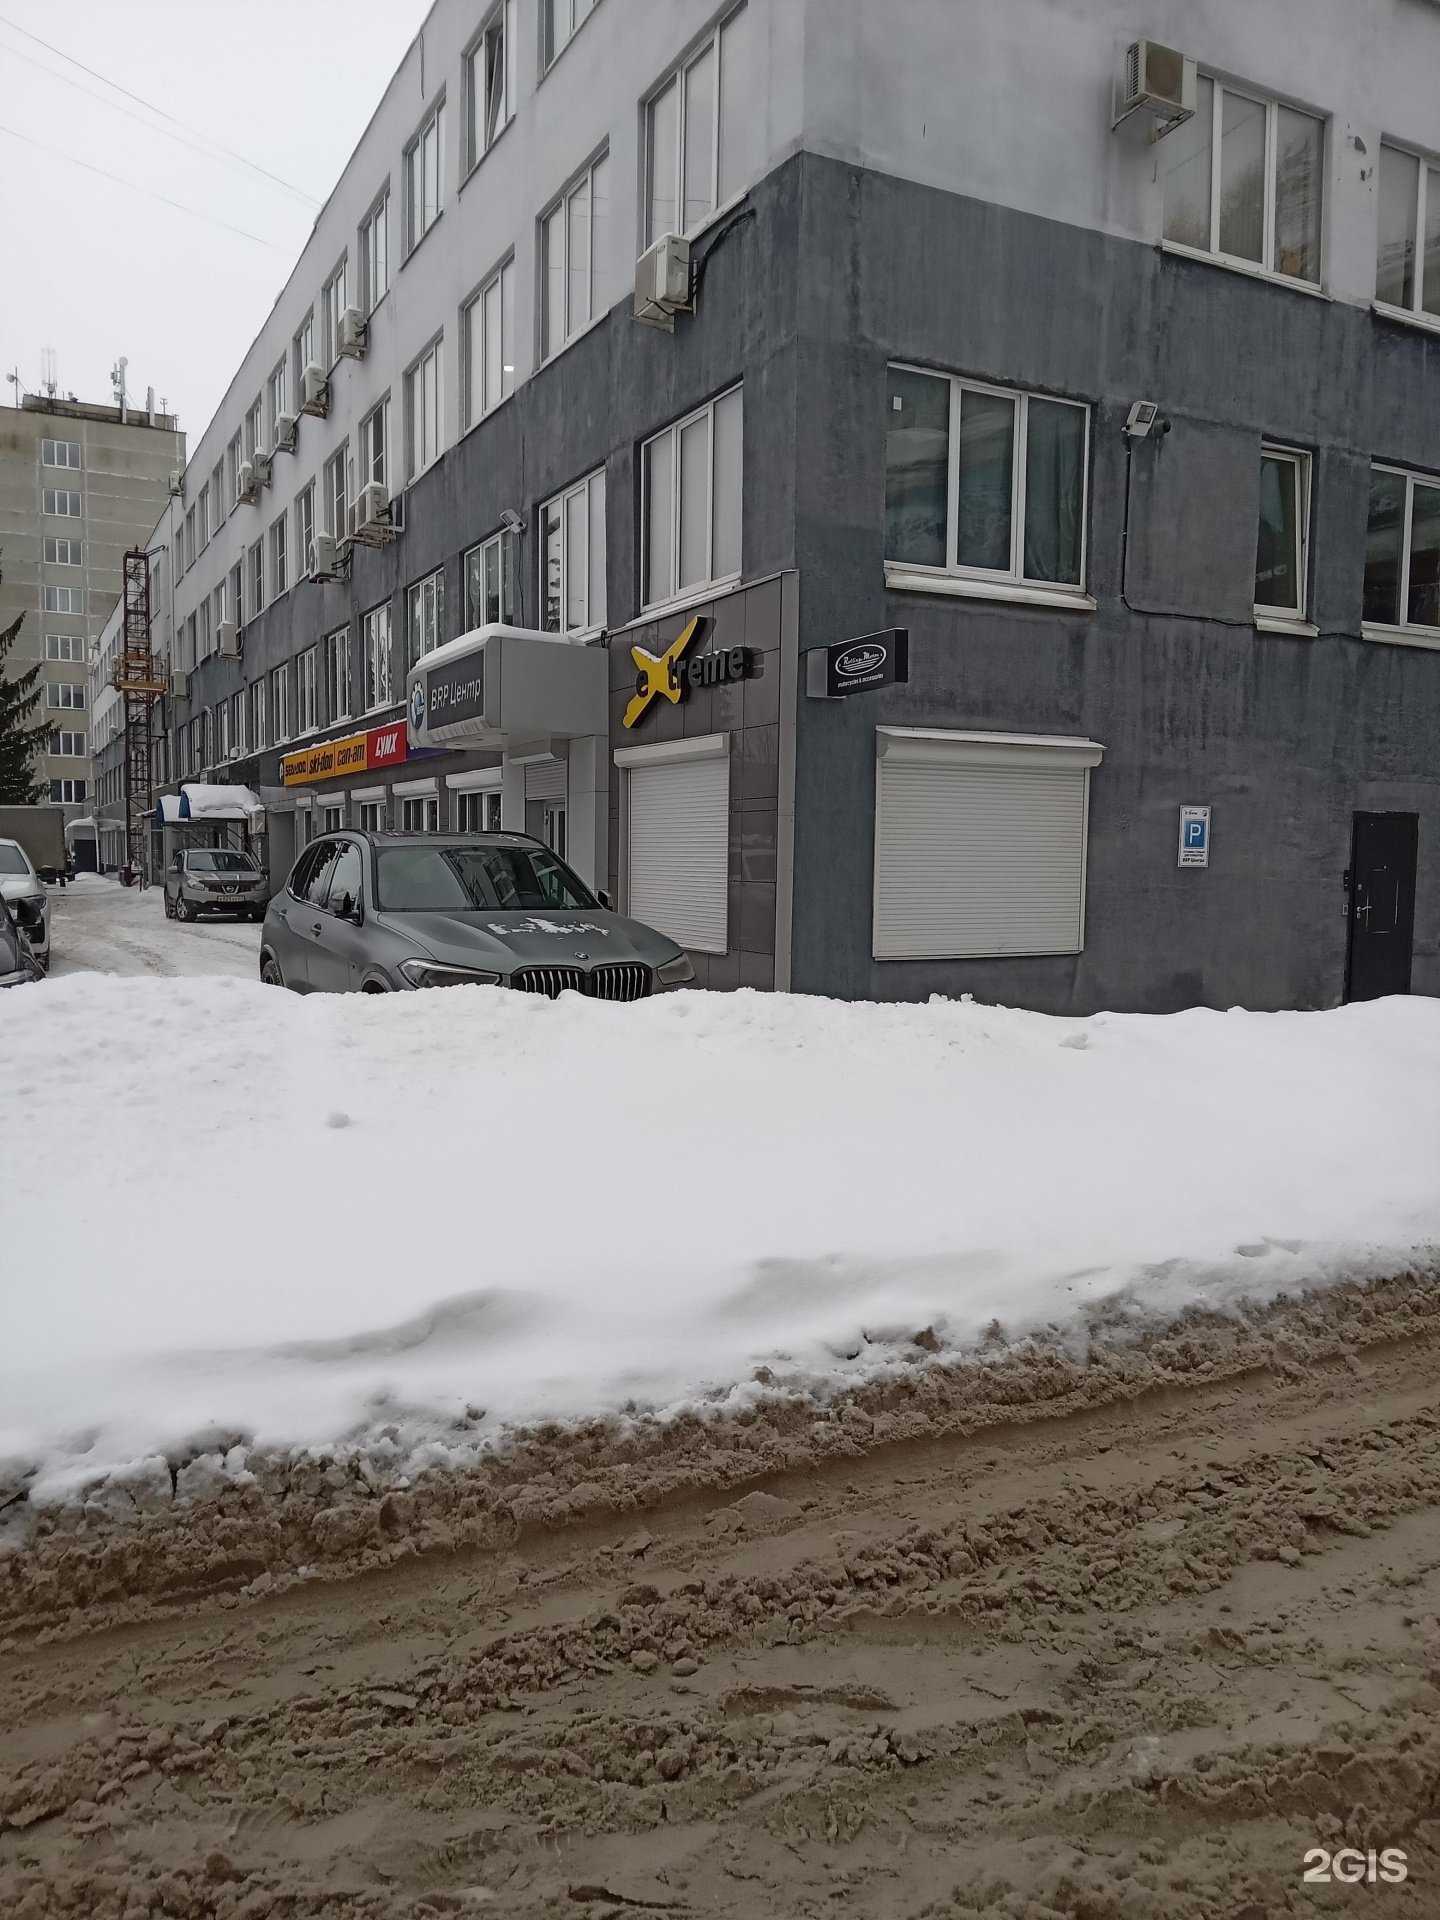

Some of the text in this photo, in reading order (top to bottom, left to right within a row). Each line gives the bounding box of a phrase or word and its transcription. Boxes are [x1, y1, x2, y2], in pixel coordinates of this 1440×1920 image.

[431, 679, 481, 711] BRP Центр
[1190, 824, 1201, 843] P
